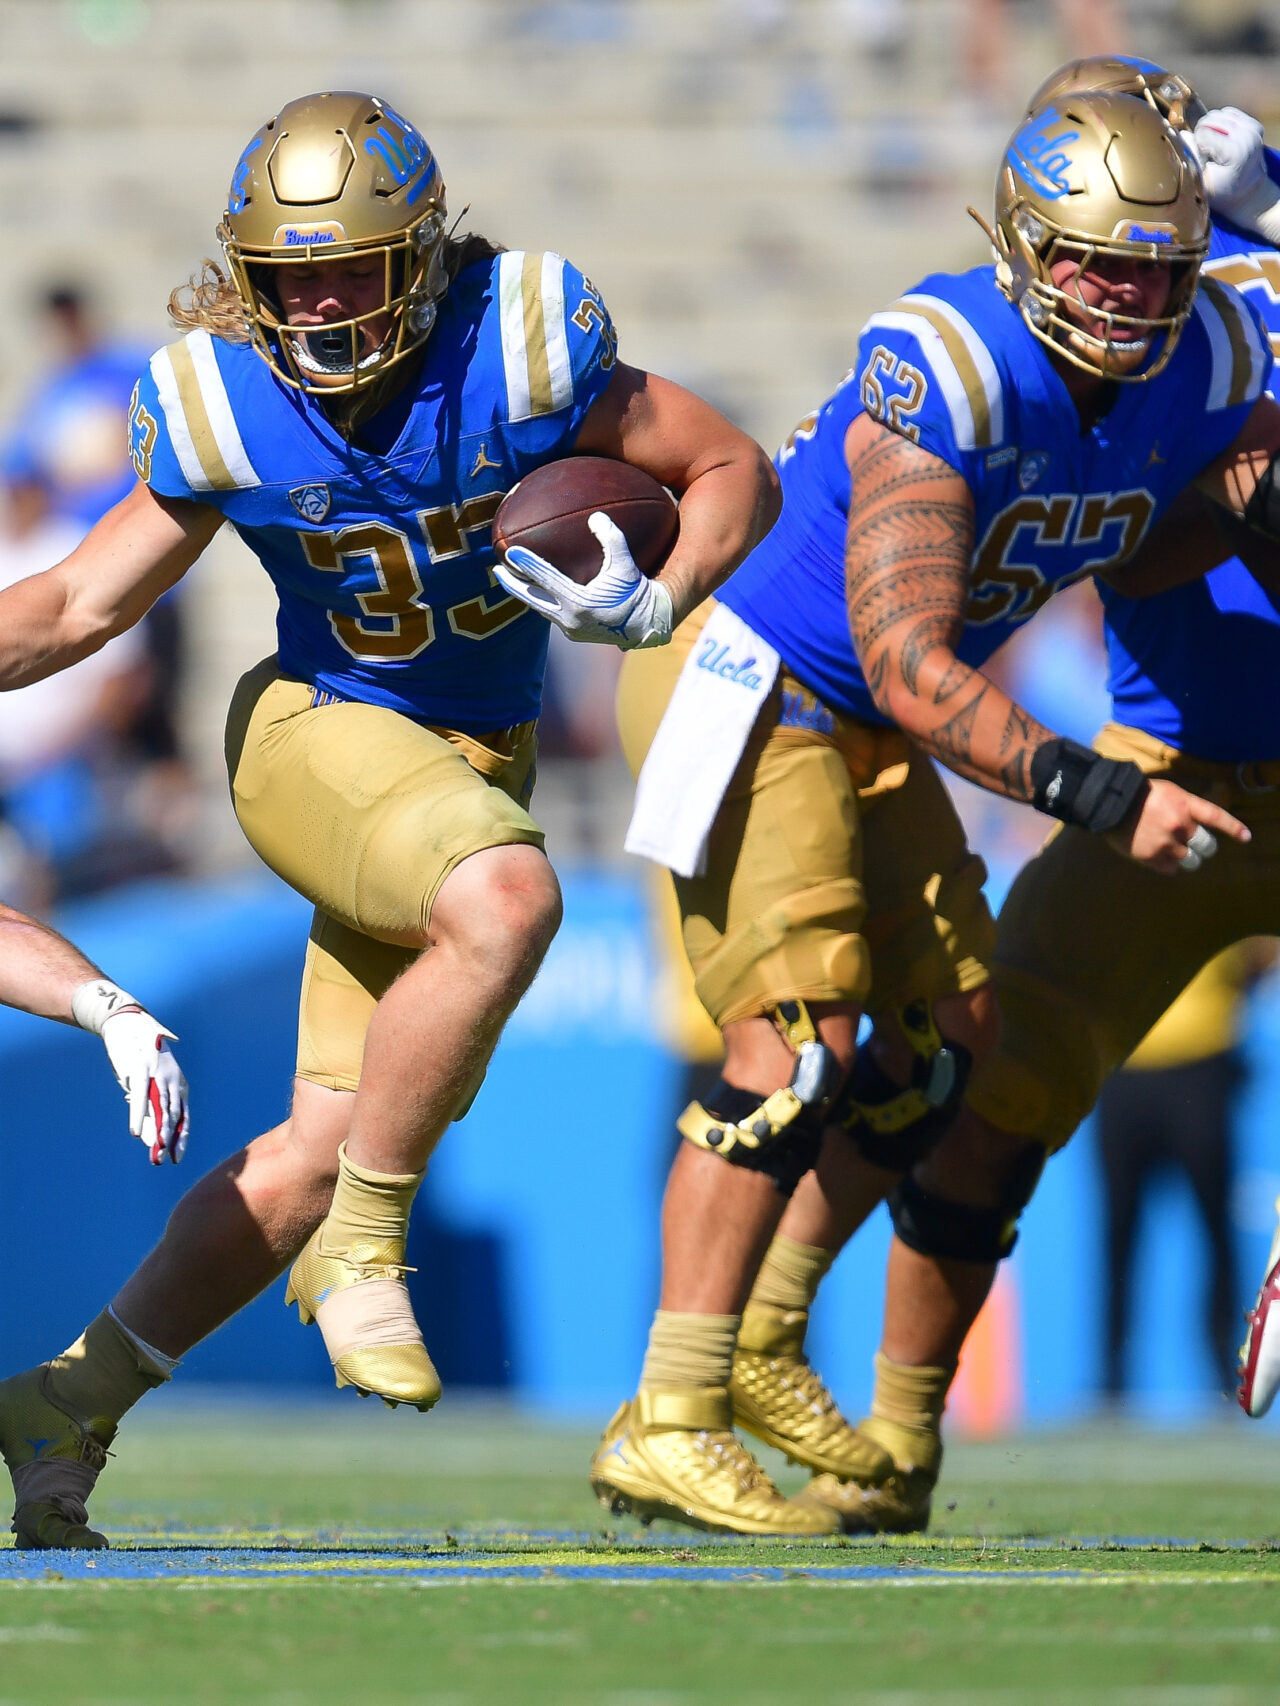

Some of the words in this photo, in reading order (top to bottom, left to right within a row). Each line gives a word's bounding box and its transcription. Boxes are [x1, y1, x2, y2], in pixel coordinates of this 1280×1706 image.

[283, 229, 336, 246] Bruins
[860, 344, 928, 445] 62
[304, 500, 324, 516] 12
[697, 638, 762, 690] Ucla
